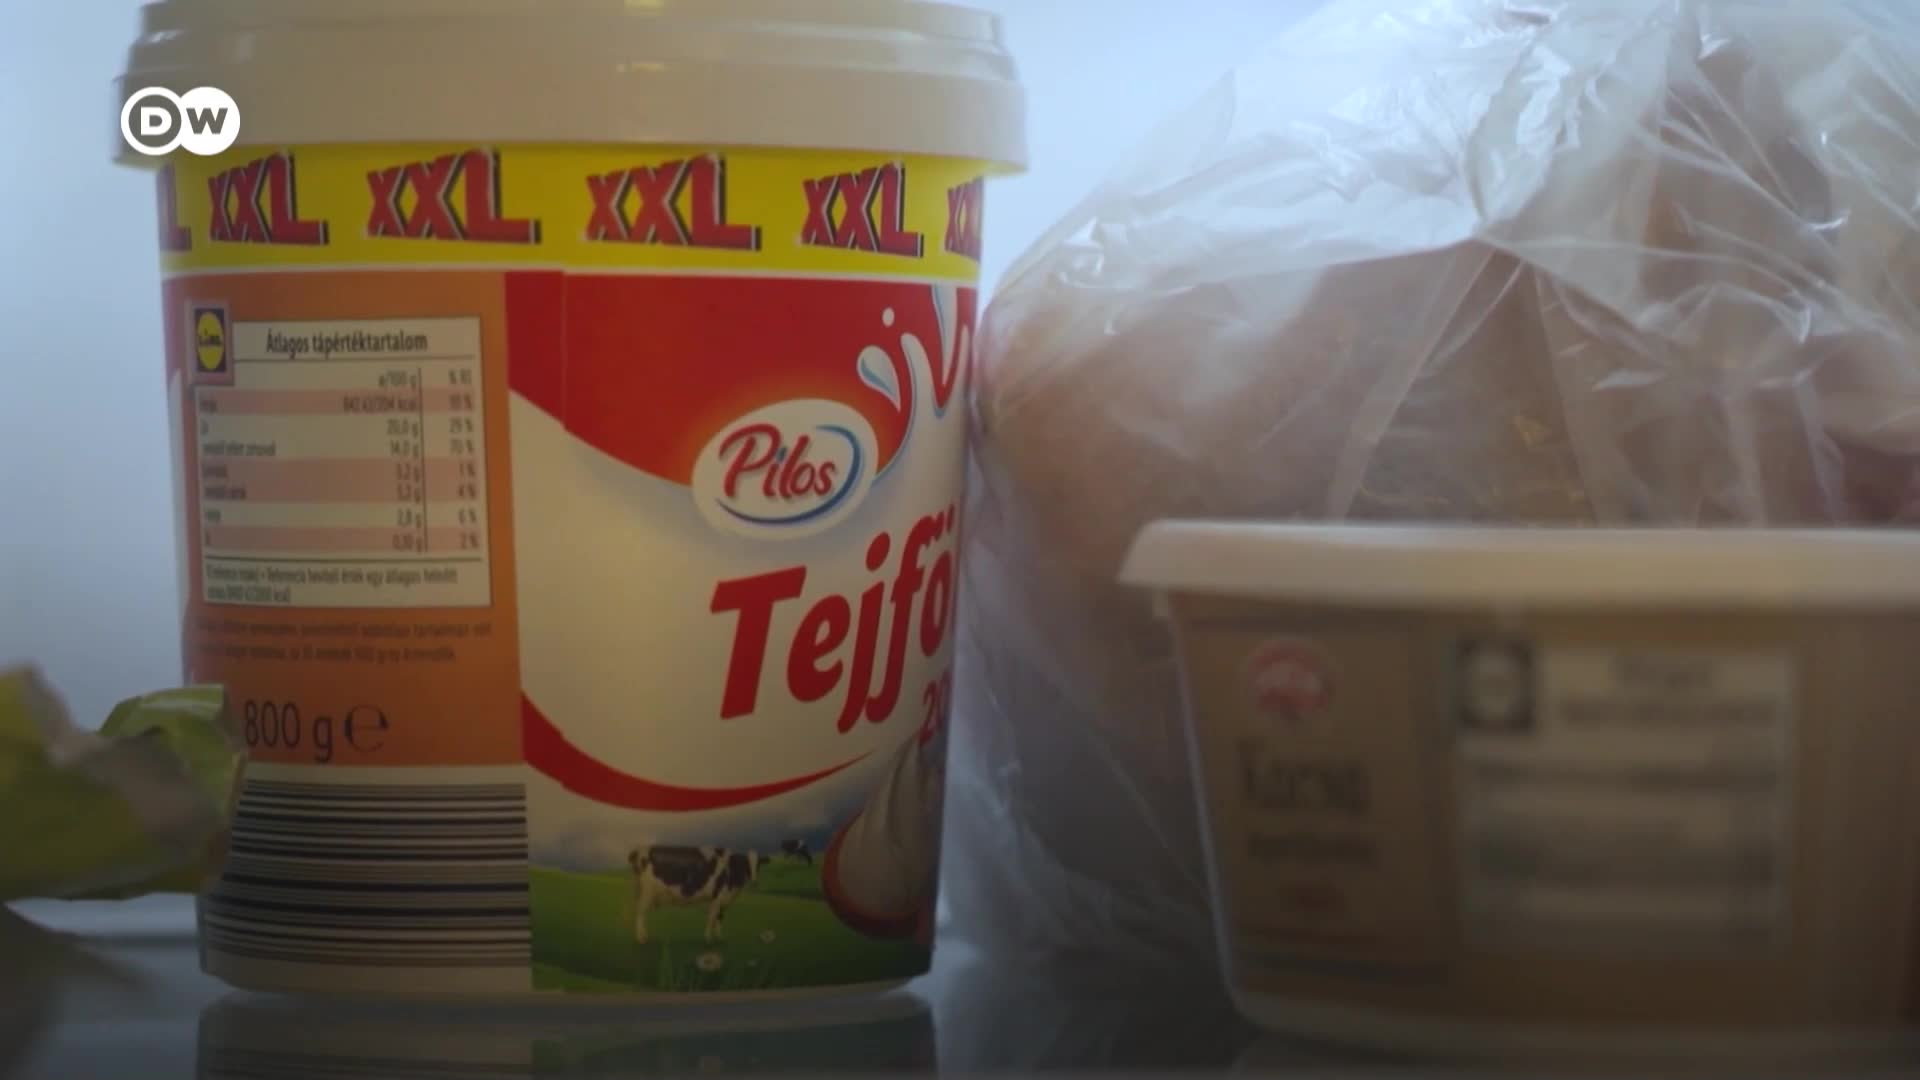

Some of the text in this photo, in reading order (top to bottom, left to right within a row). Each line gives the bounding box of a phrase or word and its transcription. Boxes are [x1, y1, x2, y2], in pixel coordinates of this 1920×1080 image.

[208, 149, 330, 246] XXL
[365, 147, 541, 245] XXL
[580, 152, 762, 252] XXL
[798, 159, 924, 259] XXL
[266, 328, 428, 361] Átlagos tápértéktartalom
[718, 423, 838, 500] Pilos
[710, 503, 955, 734] Tejfö
[244, 700, 300, 749] 800
[312, 716, 334, 763] g
